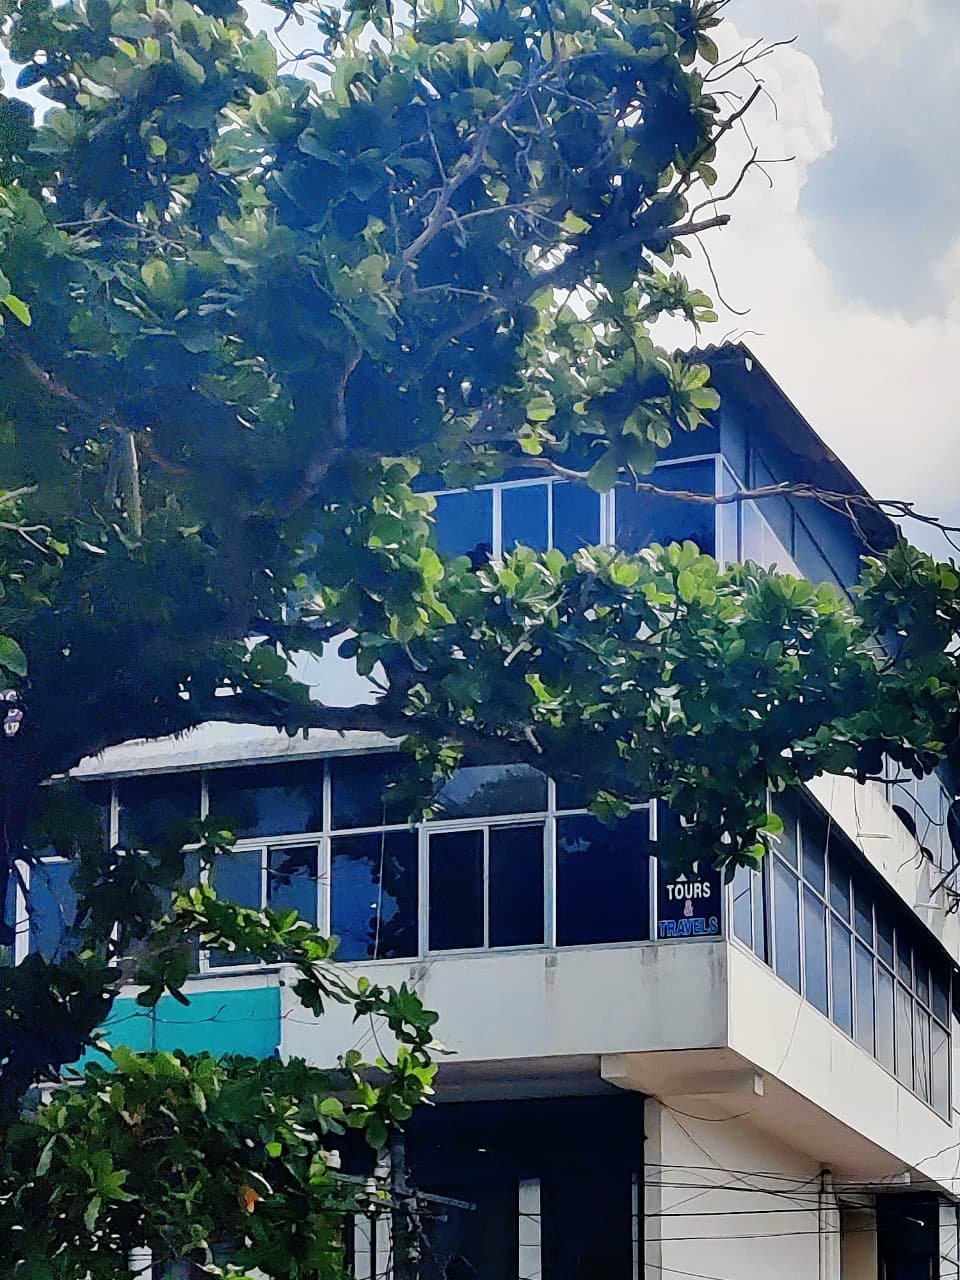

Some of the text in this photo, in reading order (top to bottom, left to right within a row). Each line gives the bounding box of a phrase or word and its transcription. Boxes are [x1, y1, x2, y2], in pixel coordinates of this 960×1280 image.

[666, 882, 711, 900] TOURS
[683, 899, 694, 917] &
[658, 916, 718, 937] TRAVELS
